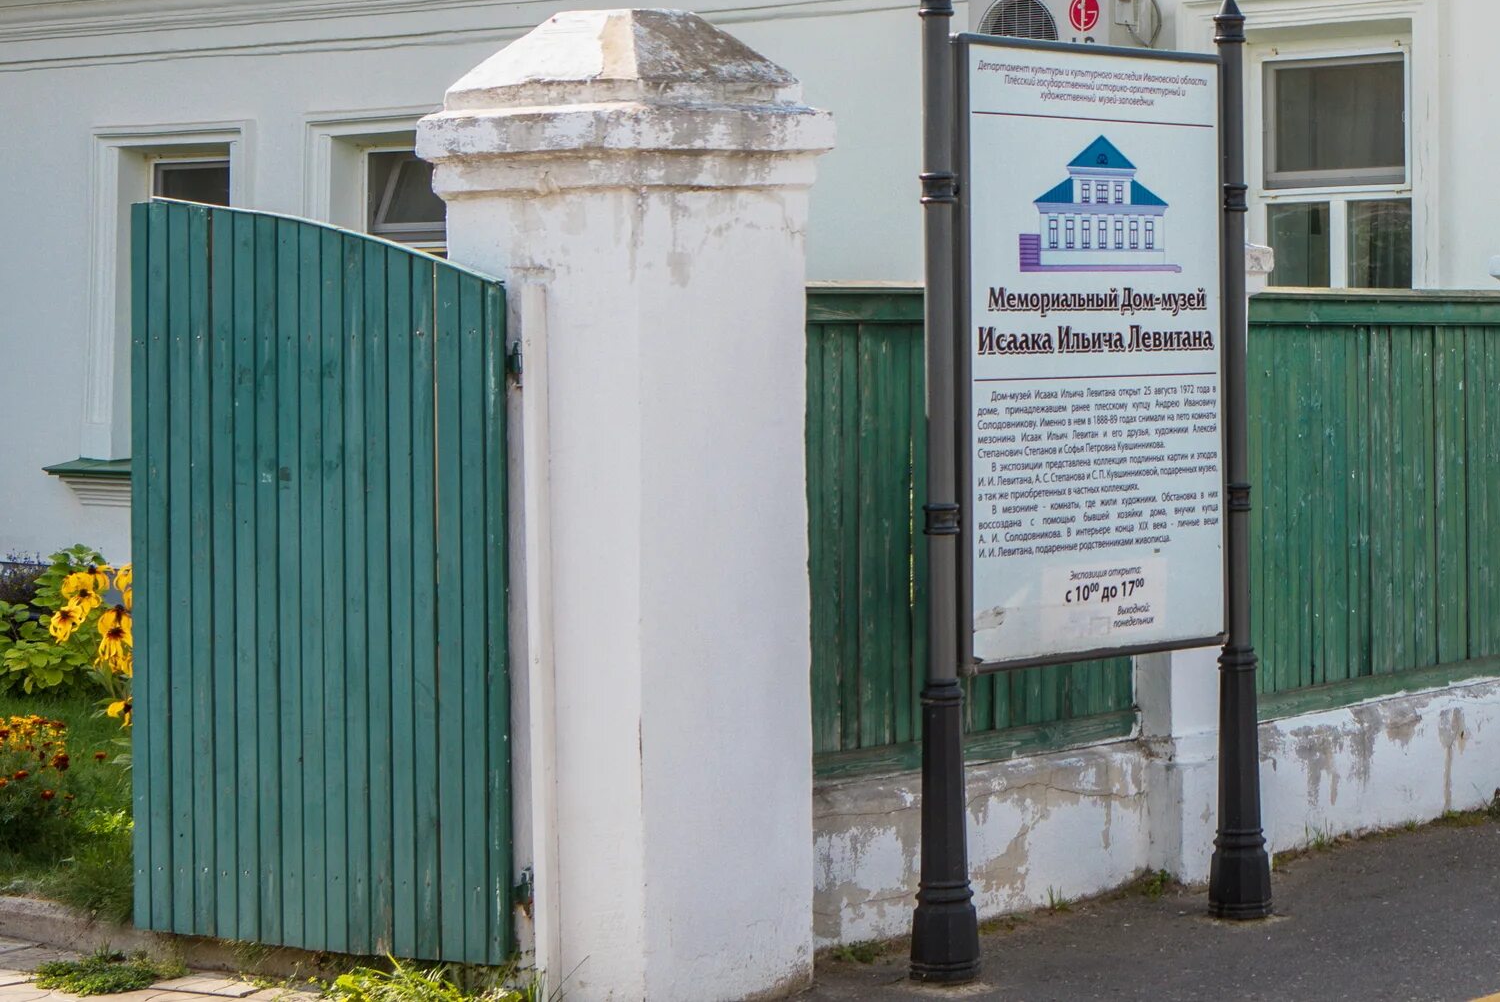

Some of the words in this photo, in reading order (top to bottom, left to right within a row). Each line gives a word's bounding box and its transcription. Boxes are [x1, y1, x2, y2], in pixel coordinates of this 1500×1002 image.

[978, 60, 1030, 74] Департамент
[1031, 65, 1064, 77] культуры
[1071, 67, 1112, 80] культурного
[1113, 69, 1142, 81] наследия
[1143, 71, 1179, 84] Ивановской
[1180, 74, 1207, 86] области
[1037, 78, 1095, 92] государственный
[1096, 82, 1181, 96] историко-архитектурный
[1040, 90, 1096, 103] художественный
[1098, 95, 1154, 107] музей-заповедник
[988, 287, 1119, 318] Мемориальный
[1121, 287, 1206, 315] Дом-музей
[978, 327, 1053, 355] Исаака
[1057, 325, 1125, 353] Ильича
[1128, 325, 1214, 351] Левитана
[991, 390, 1031, 402] Дом-музей
[1035, 390, 1058, 399] Исаака
[1061, 389, 1083, 398] Ильича
[1087, 388, 1115, 397] Левитана
[1119, 388, 1141, 398] открыт
[1144, 386, 1151, 395] 25
[1154, 387, 1177, 397] августа
[1180, 385, 1194, 394] 1972
[1197, 386, 1210, 394] года
[977, 408, 999, 417] доме,
[1005, 405, 1066, 417] принадлежавшем
[1072, 403, 1090, 413] ранее
[1132, 401, 1150, 410] купцу
[1155, 400, 1180, 409] Андрею
[1184, 398, 1216, 408] Ивановичу
[978, 421, 1038, 430] Солодовникову.
[1040, 418, 1065, 427] Именно
[1094, 415, 1117, 424] 1888-89
[1119, 415, 1136, 424] годах
[1139, 414, 1165, 422] снимали
[978, 434, 1015, 444] мезонина
[1021, 433, 1041, 442] Исаак
[1047, 432, 1068, 441] Ильич
[1072, 430, 1098, 438] Левитан
[1112, 430, 1122, 438] его
[1127, 428, 1150, 438] друзья,
[1155, 426, 1188, 437] художники
[1193, 424, 1216, 432] Алексей
[978, 448, 1023, 458] Степанович
[1024, 446, 1056, 457] Степанов
[1064, 444, 1084, 454] Софья
[1086, 443, 1116, 453] Петровна
[1118, 442, 1165, 451] Кувшинникова.
[992, 462, 996, 472] В
[1000, 461, 1043, 472] экспозиции
[1046, 458, 1091, 469] представлена
[1094, 456, 1127, 465] коллекция
[1130, 454, 1164, 463] подлинных
[1167, 452, 1188, 462] картин
[1197, 451, 1217, 460] этюдов
[978, 477, 985, 486] И.
[988, 477, 996, 486] И.
[997, 476, 1033, 486] Левитана,
[1051, 473, 1085, 482] Степанова
[1160, 465, 1196, 476] подаренных
[985, 493, 996, 501] так
[998, 492, 1008, 500] же
[1073, 485, 1099, 494] частных
[992, 505, 997, 514] В
[1002, 504, 1038, 513] мезонине
[1050, 502, 1081, 511] комнаты,
[1085, 500, 1096, 508] где
[1100, 498, 1117, 506] жили
[1122, 496, 1157, 507] художники.
[1162, 492, 1196, 502] Обстановка
[979, 519, 1022, 530] воссоздана
[1043, 516, 1076, 526] помощью
[1083, 511, 1109, 522] бывшей
[1117, 509, 1142, 519] хозяйки
[1150, 508, 1167, 518] дома,
[1175, 507, 1195, 516] внучки
[1202, 504, 1218, 514] купца
[979, 535, 986, 544] А.
[992, 533, 999, 543] И.
[1005, 531, 1062, 542] Солодовникова.
[1067, 528, 1071, 537] В
[1076, 526, 1110, 536] интерьере
[1115, 525, 1134, 534] конца
[1139, 522, 1148, 531] XIX
[1153, 521, 1167, 530] века
[1177, 519, 1199, 527] личные
[1204, 517, 1218, 526] вещи
[979, 549, 986, 558] И.
[989, 548, 996, 558] И.
[998, 546, 1034, 558] Левитана,
[1035, 543, 1077, 555] подаренные
[1079, 538, 1133, 552] родственниками
[1135, 534, 1171, 545] живописца.
[1070, 569, 1107, 580] Экспозиция
[1108, 566, 1141, 577] открыта:
[1066, 590, 1072, 603] с
[1101, 587, 1117, 603] до
[1113, 617, 1154, 628] понедельник
